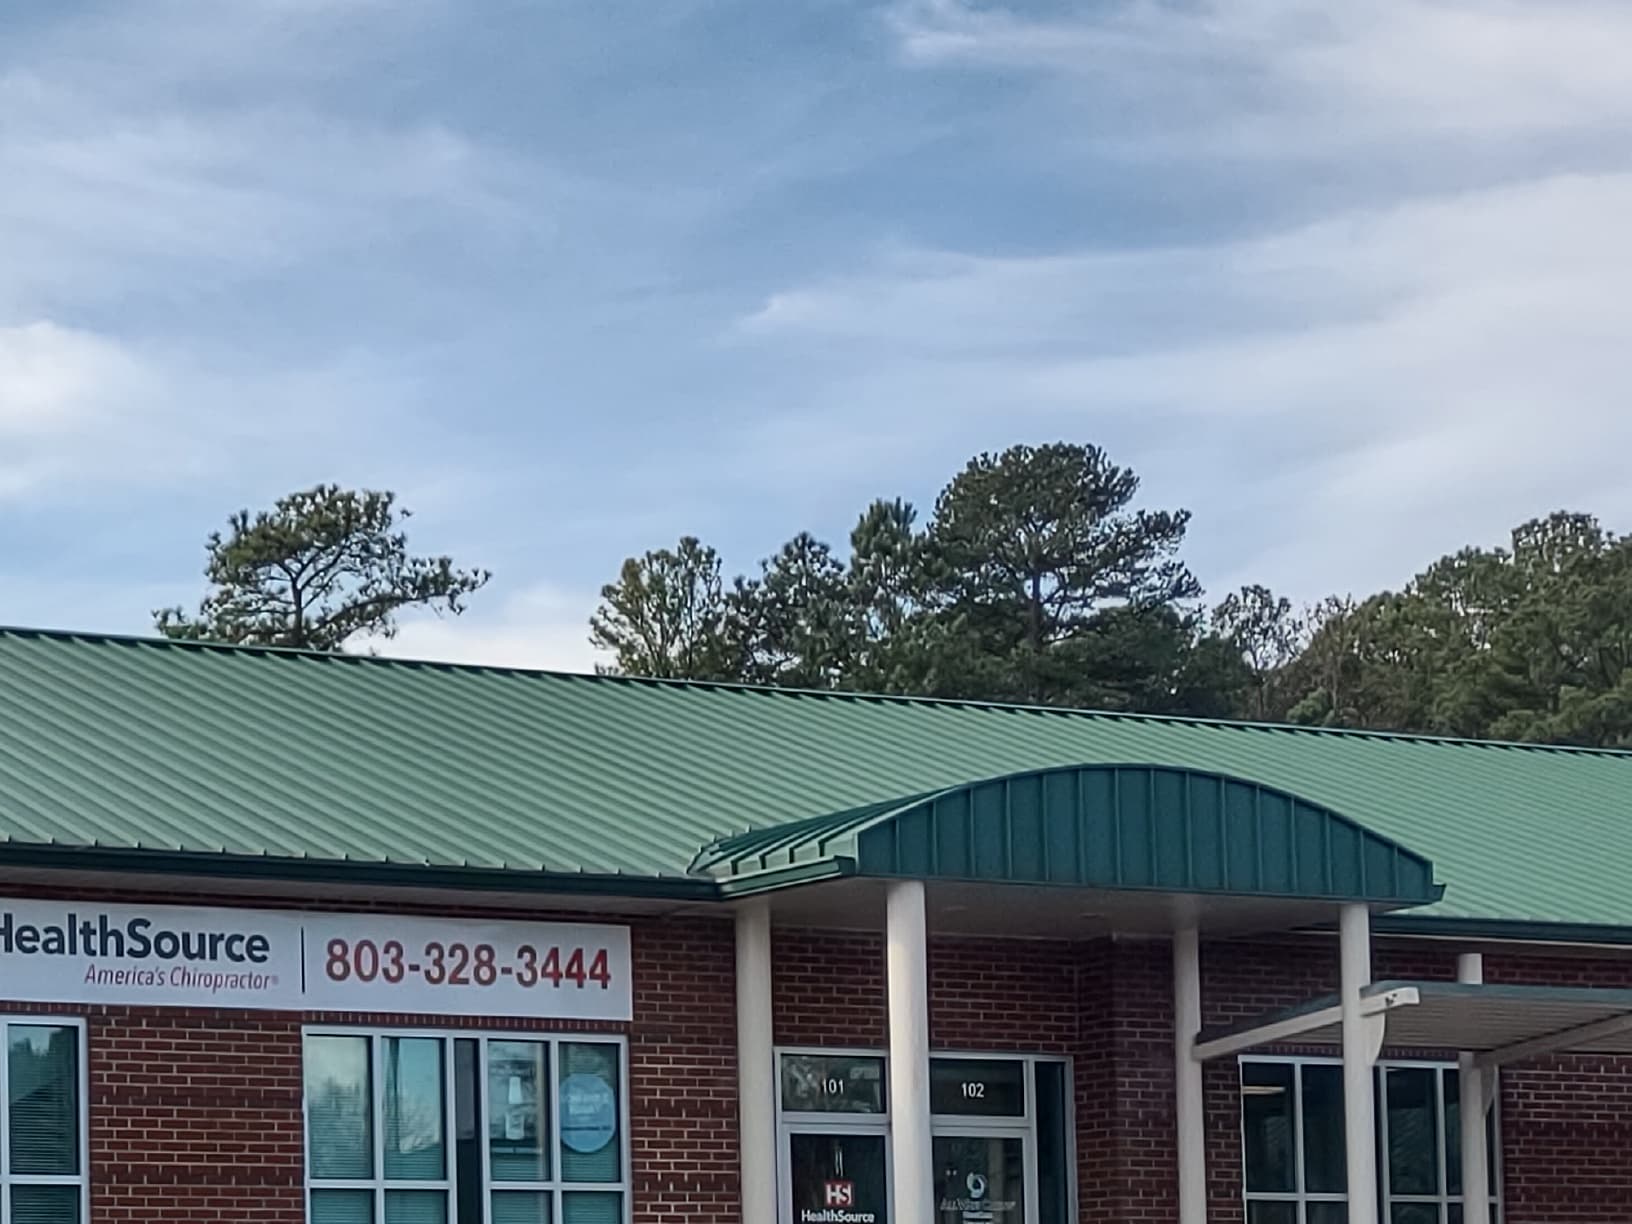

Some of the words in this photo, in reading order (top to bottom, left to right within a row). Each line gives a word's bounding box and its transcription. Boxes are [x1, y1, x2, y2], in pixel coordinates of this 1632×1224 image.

[325, 938, 611, 990] 803-328-3444
[84, 963, 166, 987] America's
[822, 1078, 845, 1095] 101
[961, 1082, 985, 1098] 102
[801, 1209, 875, 1223] HealthSource
